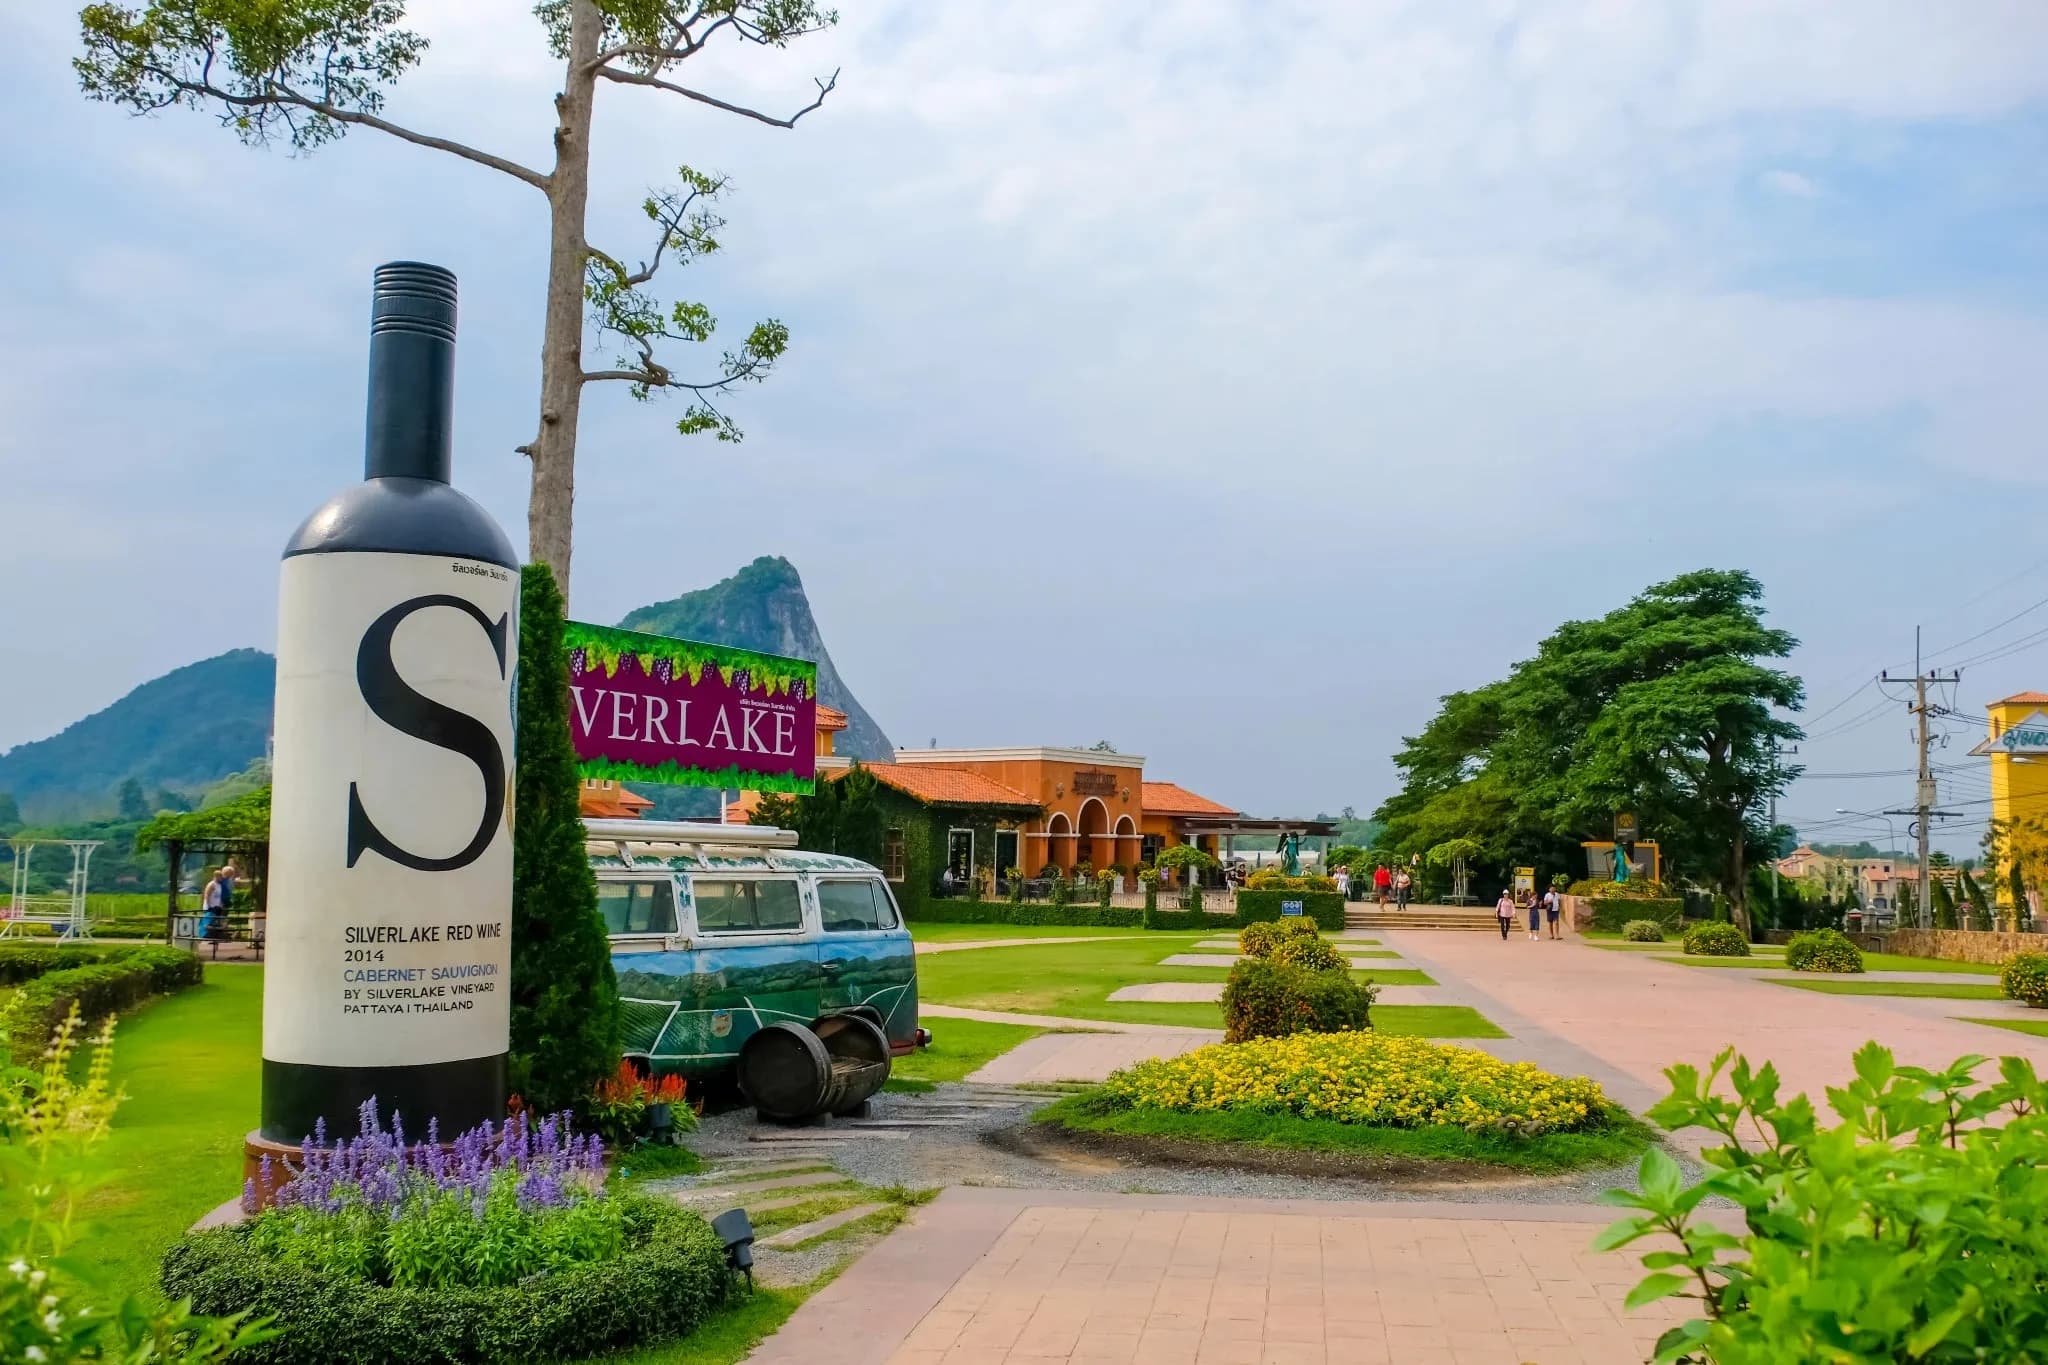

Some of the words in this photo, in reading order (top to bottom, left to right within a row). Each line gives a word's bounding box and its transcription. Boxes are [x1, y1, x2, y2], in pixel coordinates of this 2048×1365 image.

[347, 594, 508, 872] S
[345, 926, 440, 943] SILVERLAKE
[447, 925, 473, 940] RED
[476, 922, 502, 938] WINE
[344, 950, 385, 962] 2014
[344, 968, 426, 982] CABERNET
[431, 963, 498, 980] SAUVIGNON
[344, 989, 361, 999] BY
[367, 986, 446, 999] SILVERLAKE
[450, 982, 495, 995] VINEYARD
[344, 1004, 403, 1014] PATTAYA
[413, 1000, 474, 1014] THAILAND
